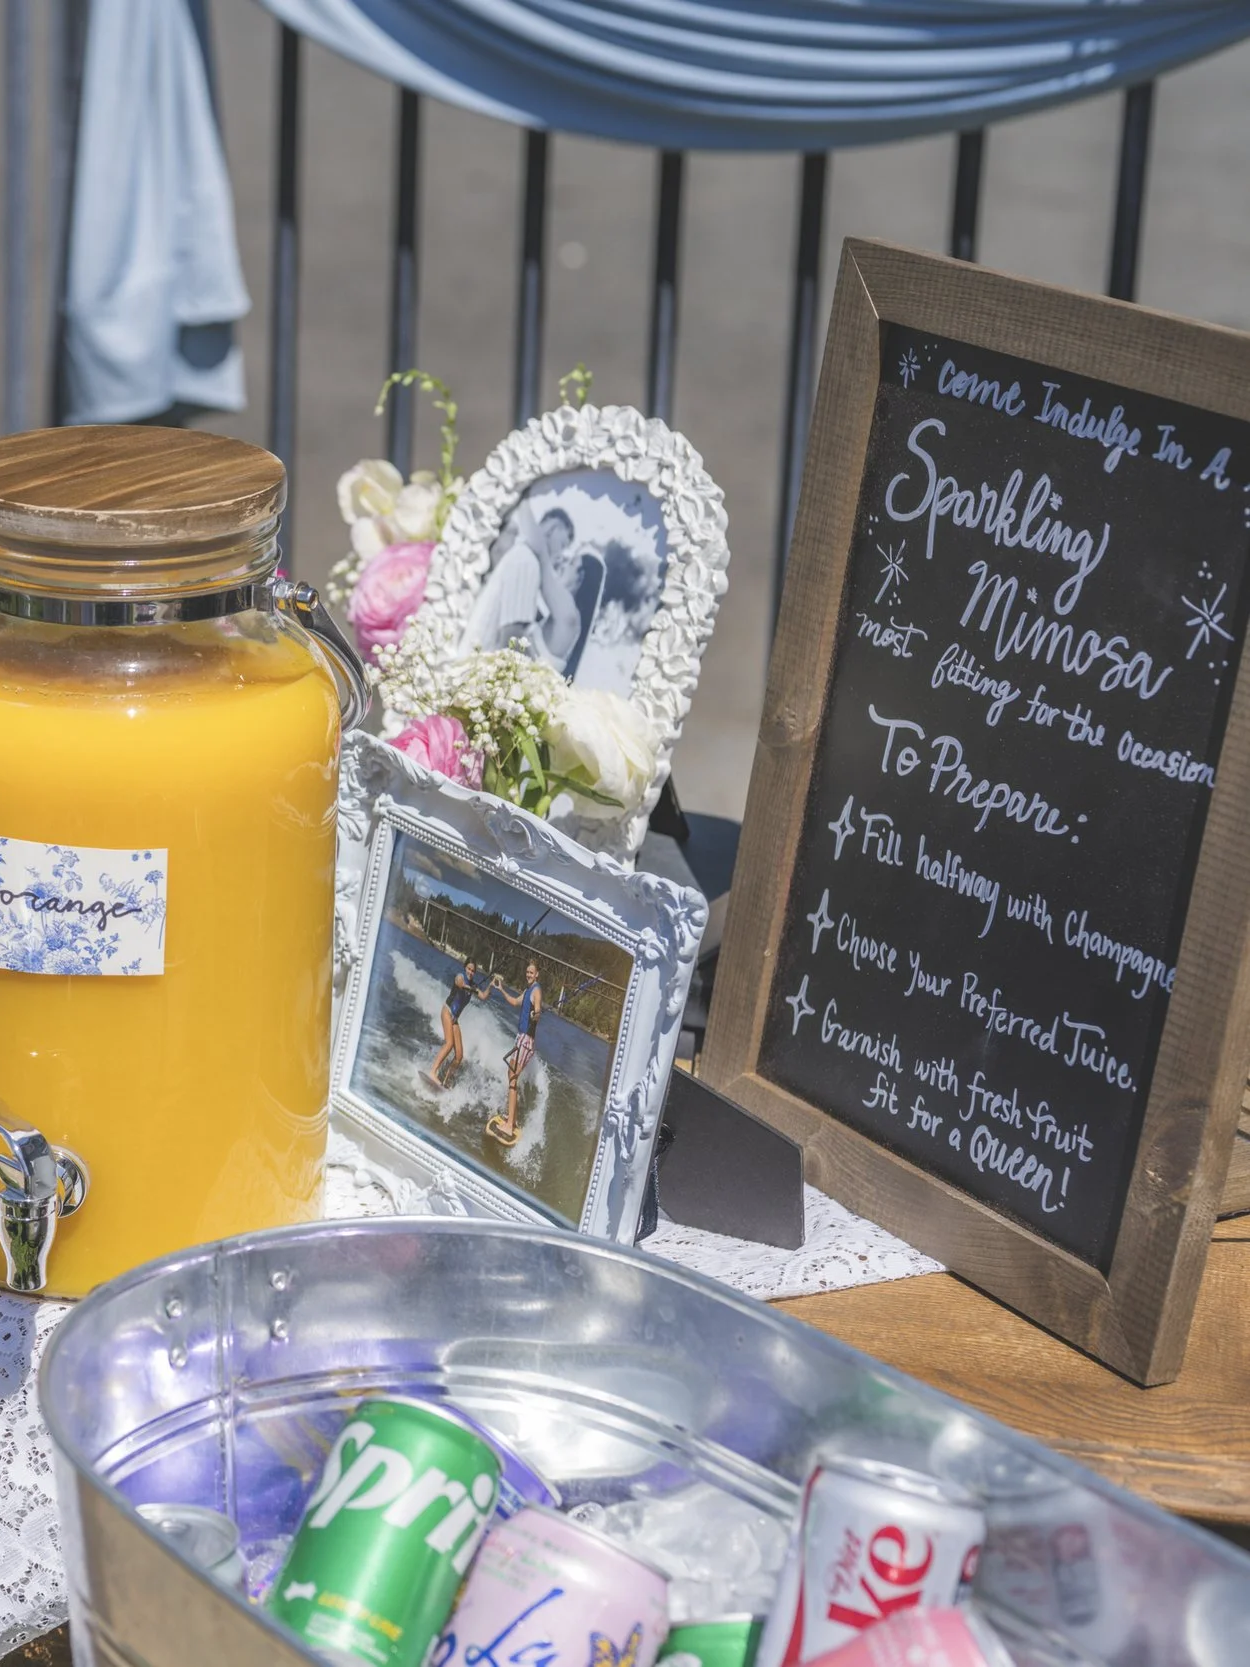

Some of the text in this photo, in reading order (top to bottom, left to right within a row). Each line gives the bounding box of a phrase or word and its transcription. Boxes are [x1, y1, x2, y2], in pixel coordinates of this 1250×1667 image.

[1034, 380, 1142, 473] Indulge
[1152, 424, 1192, 470] In
[1200, 447, 1231, 490] A
[885, 418, 1111, 615] Sparkling
[856, 612, 928, 658] most
[931, 642, 1021, 727] fitting
[1019, 686, 1064, 727] for
[1063, 703, 1105, 747] the
[959, 560, 1174, 699] Mimosa
[868, 704, 1088, 844] To Prepare:
[861, 807, 1177, 999] Fill halfway with Champagne
[821, 998, 903, 1074] Garnish
[915, 1056, 959, 1097] with
[960, 1070, 1024, 1129] fresh
[837, 913, 897, 972] Choose
[960, 972, 1059, 1056] Preferred
[1062, 1012, 1138, 1093] Juice.
[862, 1072, 899, 1115] fit
[907, 1095, 944, 1138] for
[948, 1130, 962, 1151] a
[306, 1421, 494, 1576] Spri
